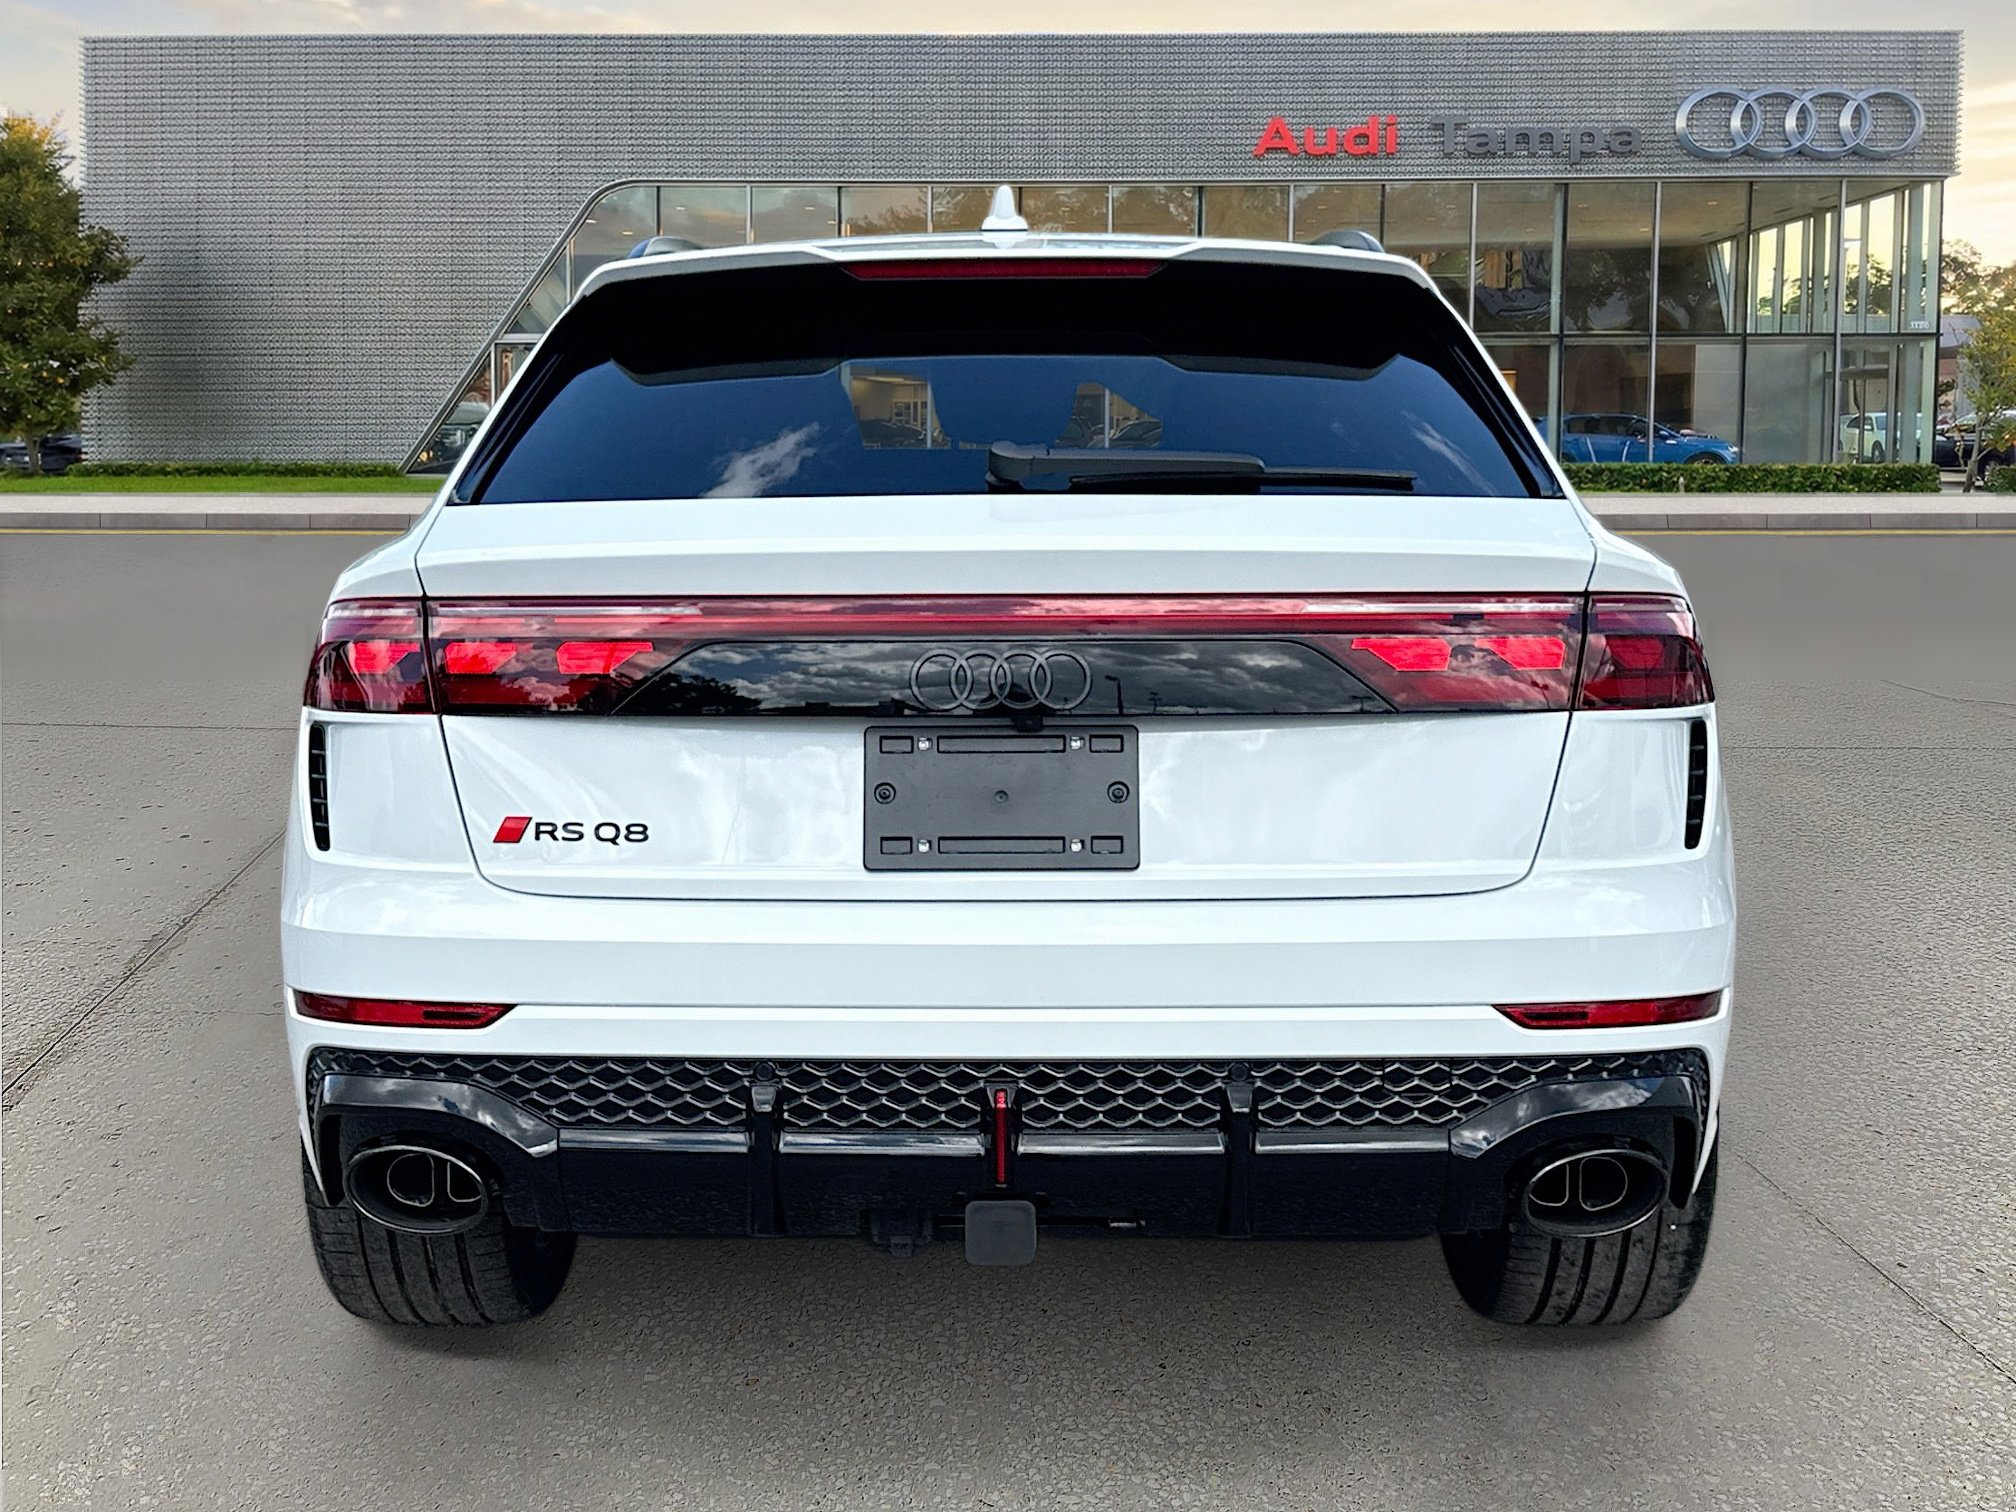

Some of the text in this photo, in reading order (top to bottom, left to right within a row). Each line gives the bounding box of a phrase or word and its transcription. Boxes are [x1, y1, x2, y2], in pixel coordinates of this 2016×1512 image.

[1253, 115, 1643, 167] Audi Tampa
[534, 821, 650, 846] RS Q8
